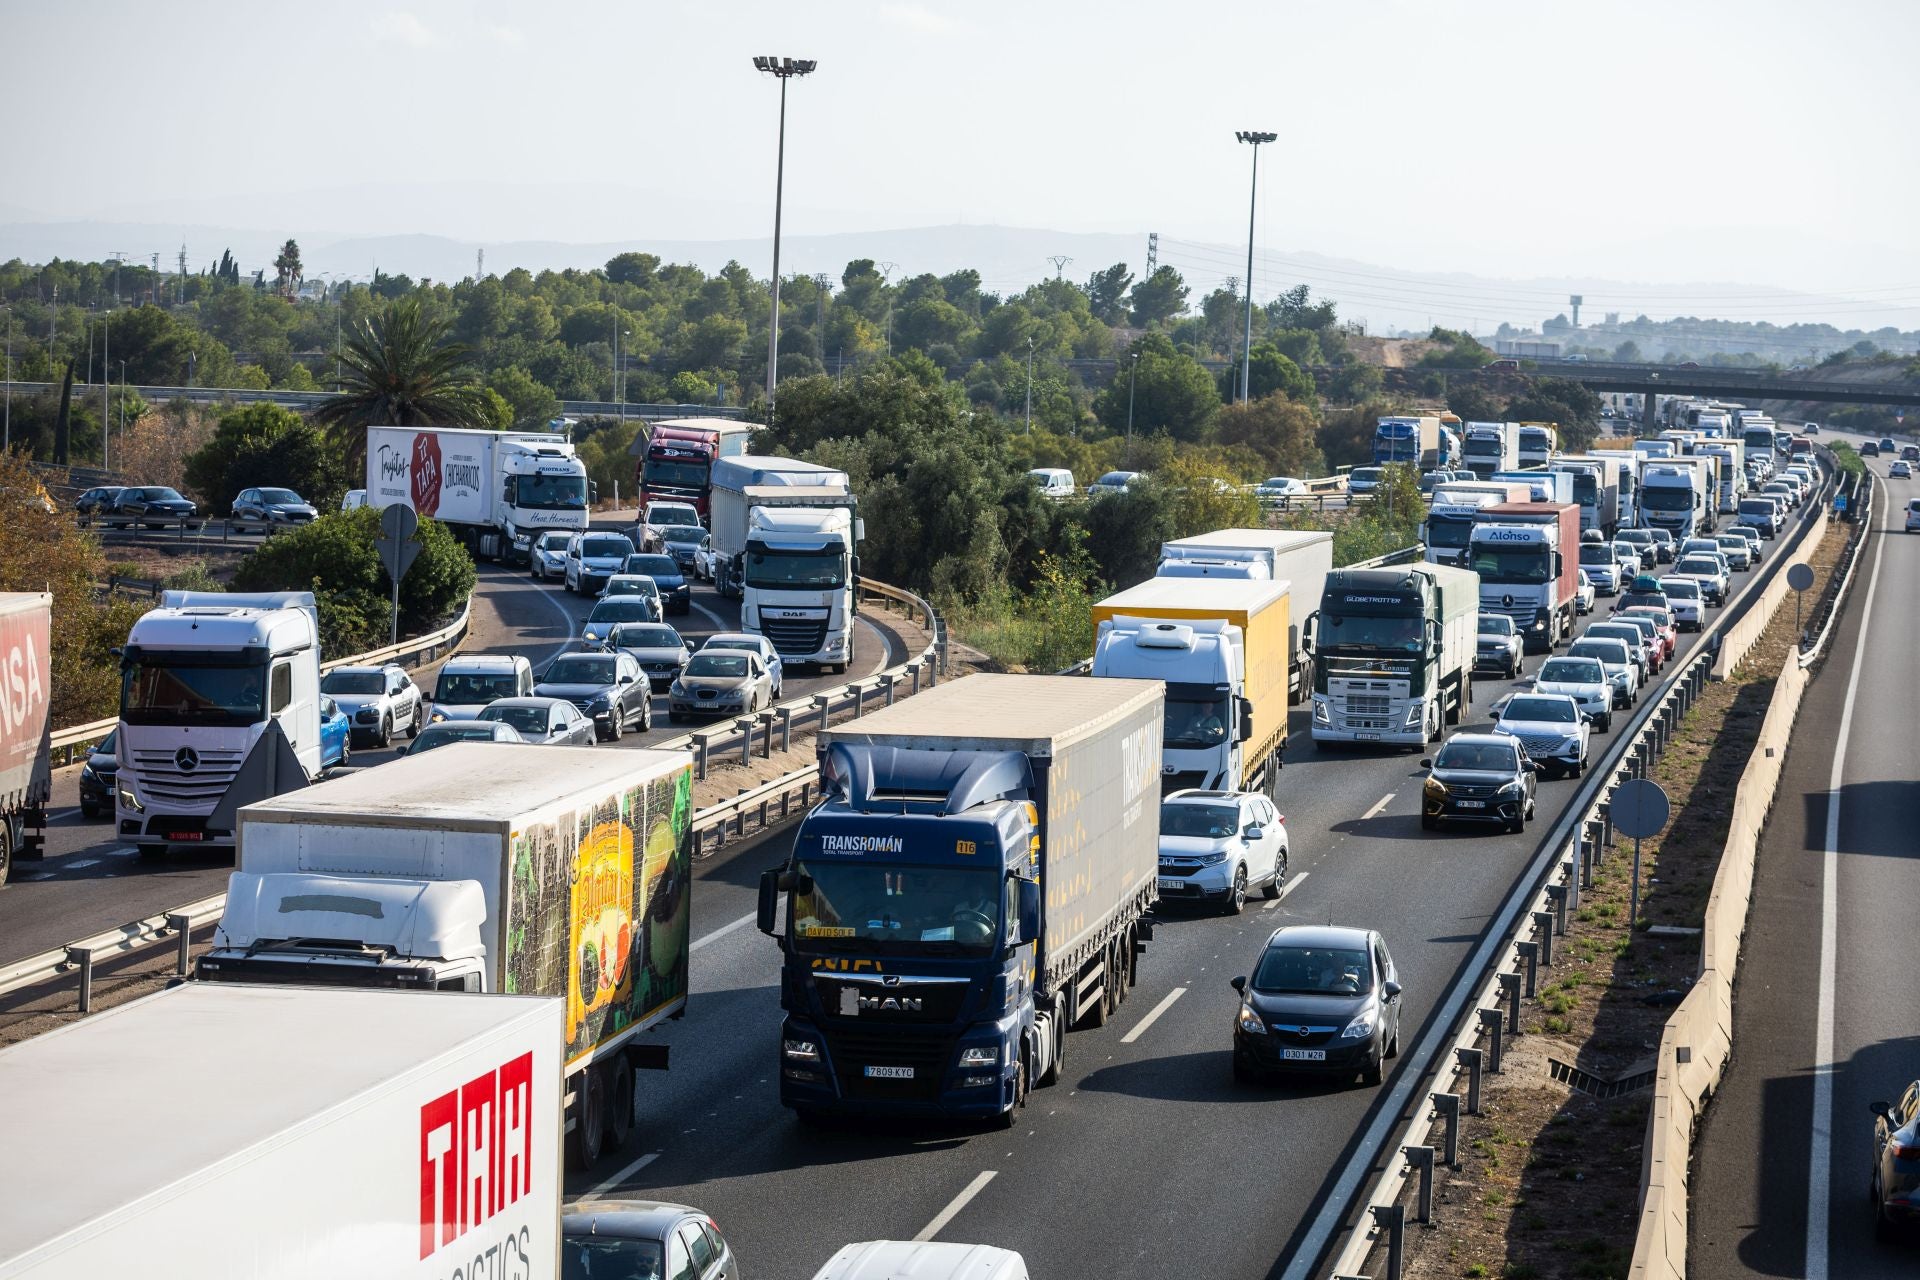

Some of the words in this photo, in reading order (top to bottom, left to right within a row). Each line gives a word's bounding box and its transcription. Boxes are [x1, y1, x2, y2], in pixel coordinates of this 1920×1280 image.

[416, 455, 436, 496] TAPA
[445, 463, 480, 492] CHICHARRICOS
[1489, 530, 1530, 540] Alonso
[1346, 596, 1401, 604] GLOBETROTTER
[822, 834, 903, 853] TRANSROMÁN
[958, 841, 975, 853] 116
[807, 927, 832, 937] DAVID
[860, 996, 922, 1011] MAN
[870, 1067, 893, 1077] 7809
[895, 1068, 913, 1078] KYC
